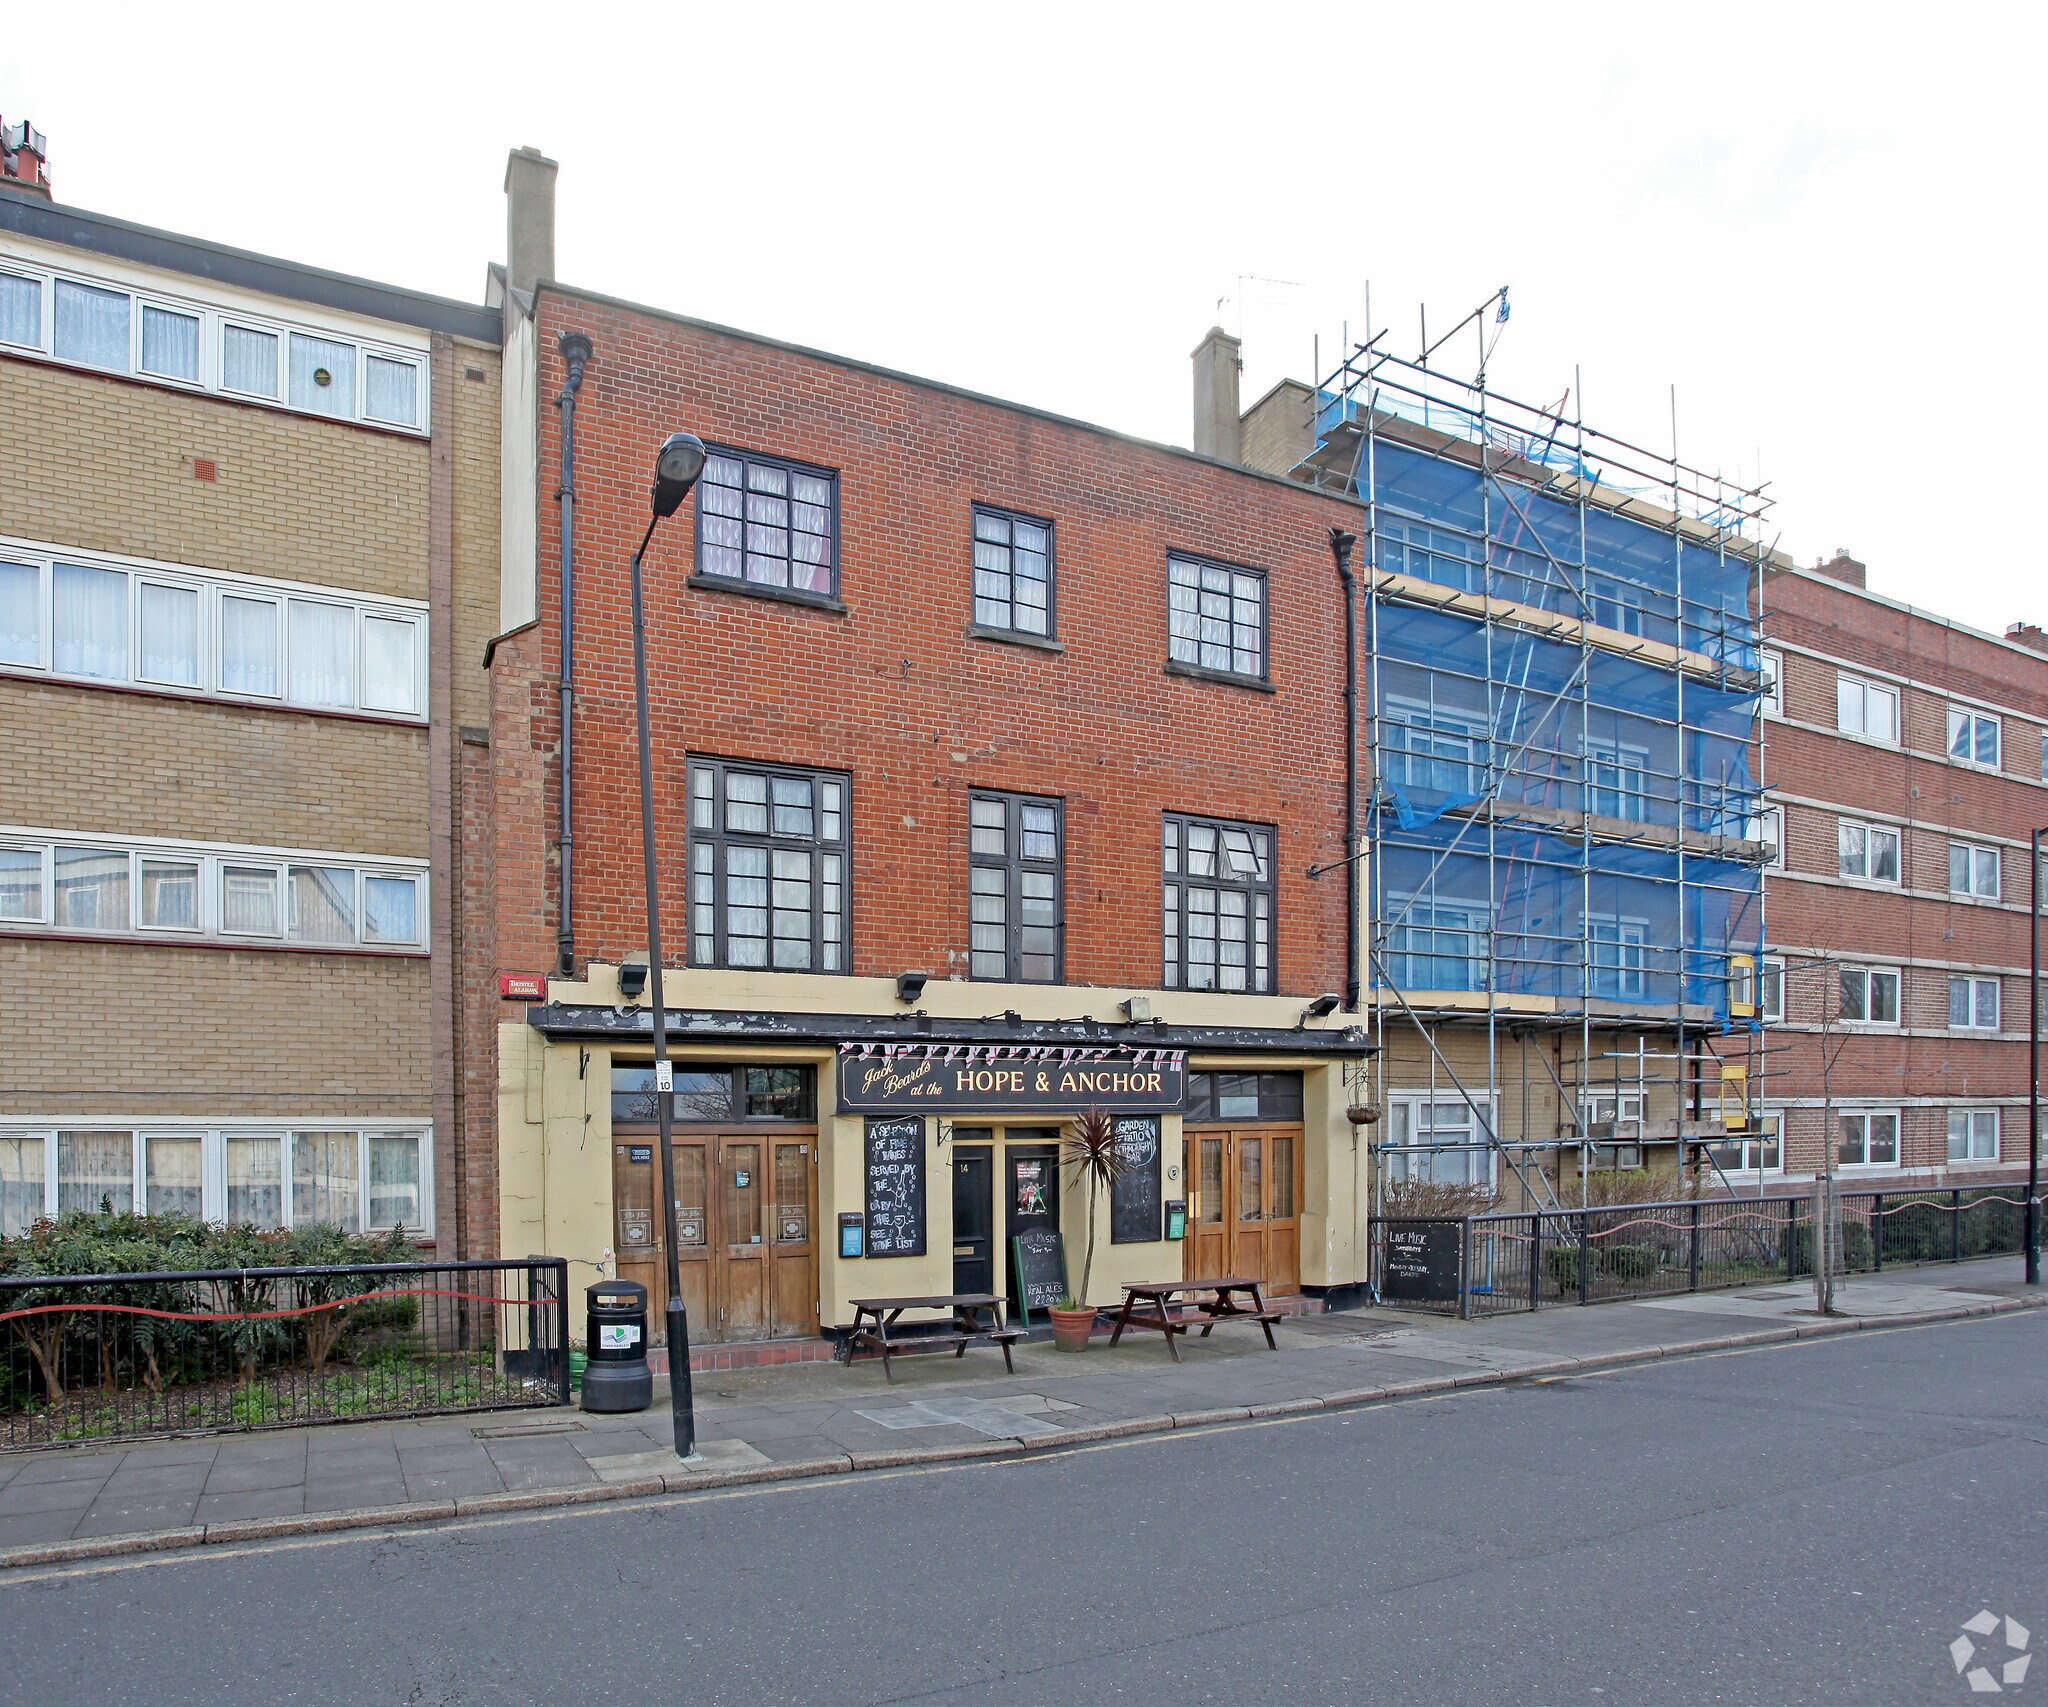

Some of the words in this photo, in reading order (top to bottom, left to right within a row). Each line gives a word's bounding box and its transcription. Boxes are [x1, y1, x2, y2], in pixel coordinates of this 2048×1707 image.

[862, 1059, 894, 1094] Jack
[883, 1060, 931, 1098] Beard's
[956, 1070, 1025, 1092] HOPE
[1034, 1072, 1050, 1092] &
[1059, 1072, 1162, 1093] ANCHOR
[660, 1081, 671, 1090] 10
[910, 1083, 924, 1096] at
[926, 1081, 942, 1096] the
[870, 1127, 878, 1140] A
[879, 1124, 918, 1138] SELECTION
[1118, 1120, 1150, 1132] GARDEN
[876, 1139, 886, 1150] OF
[890, 1138, 908, 1150] FINE
[1121, 1142, 1150, 1154] THROUGH
[882, 1150, 906, 1160] WINES
[870, 1164, 900, 1177] SERVED
[904, 1164, 916, 1176] BY
[960, 1164, 968, 1173] 14
[874, 1179, 888, 1192] THE
[874, 1213, 890, 1225] THE
[870, 1229, 886, 1240] SEE
[1036, 1233, 1057, 1244] MUSIC
[1390, 1231, 1407, 1243] LIVE
[1408, 1232, 1427, 1245] MUSIC
[872, 1238, 892, 1251] WINE
[896, 1239, 914, 1250] LIST
[1028, 1286, 1044, 1296] REAL
[1046, 1284, 1063, 1294] ALES
